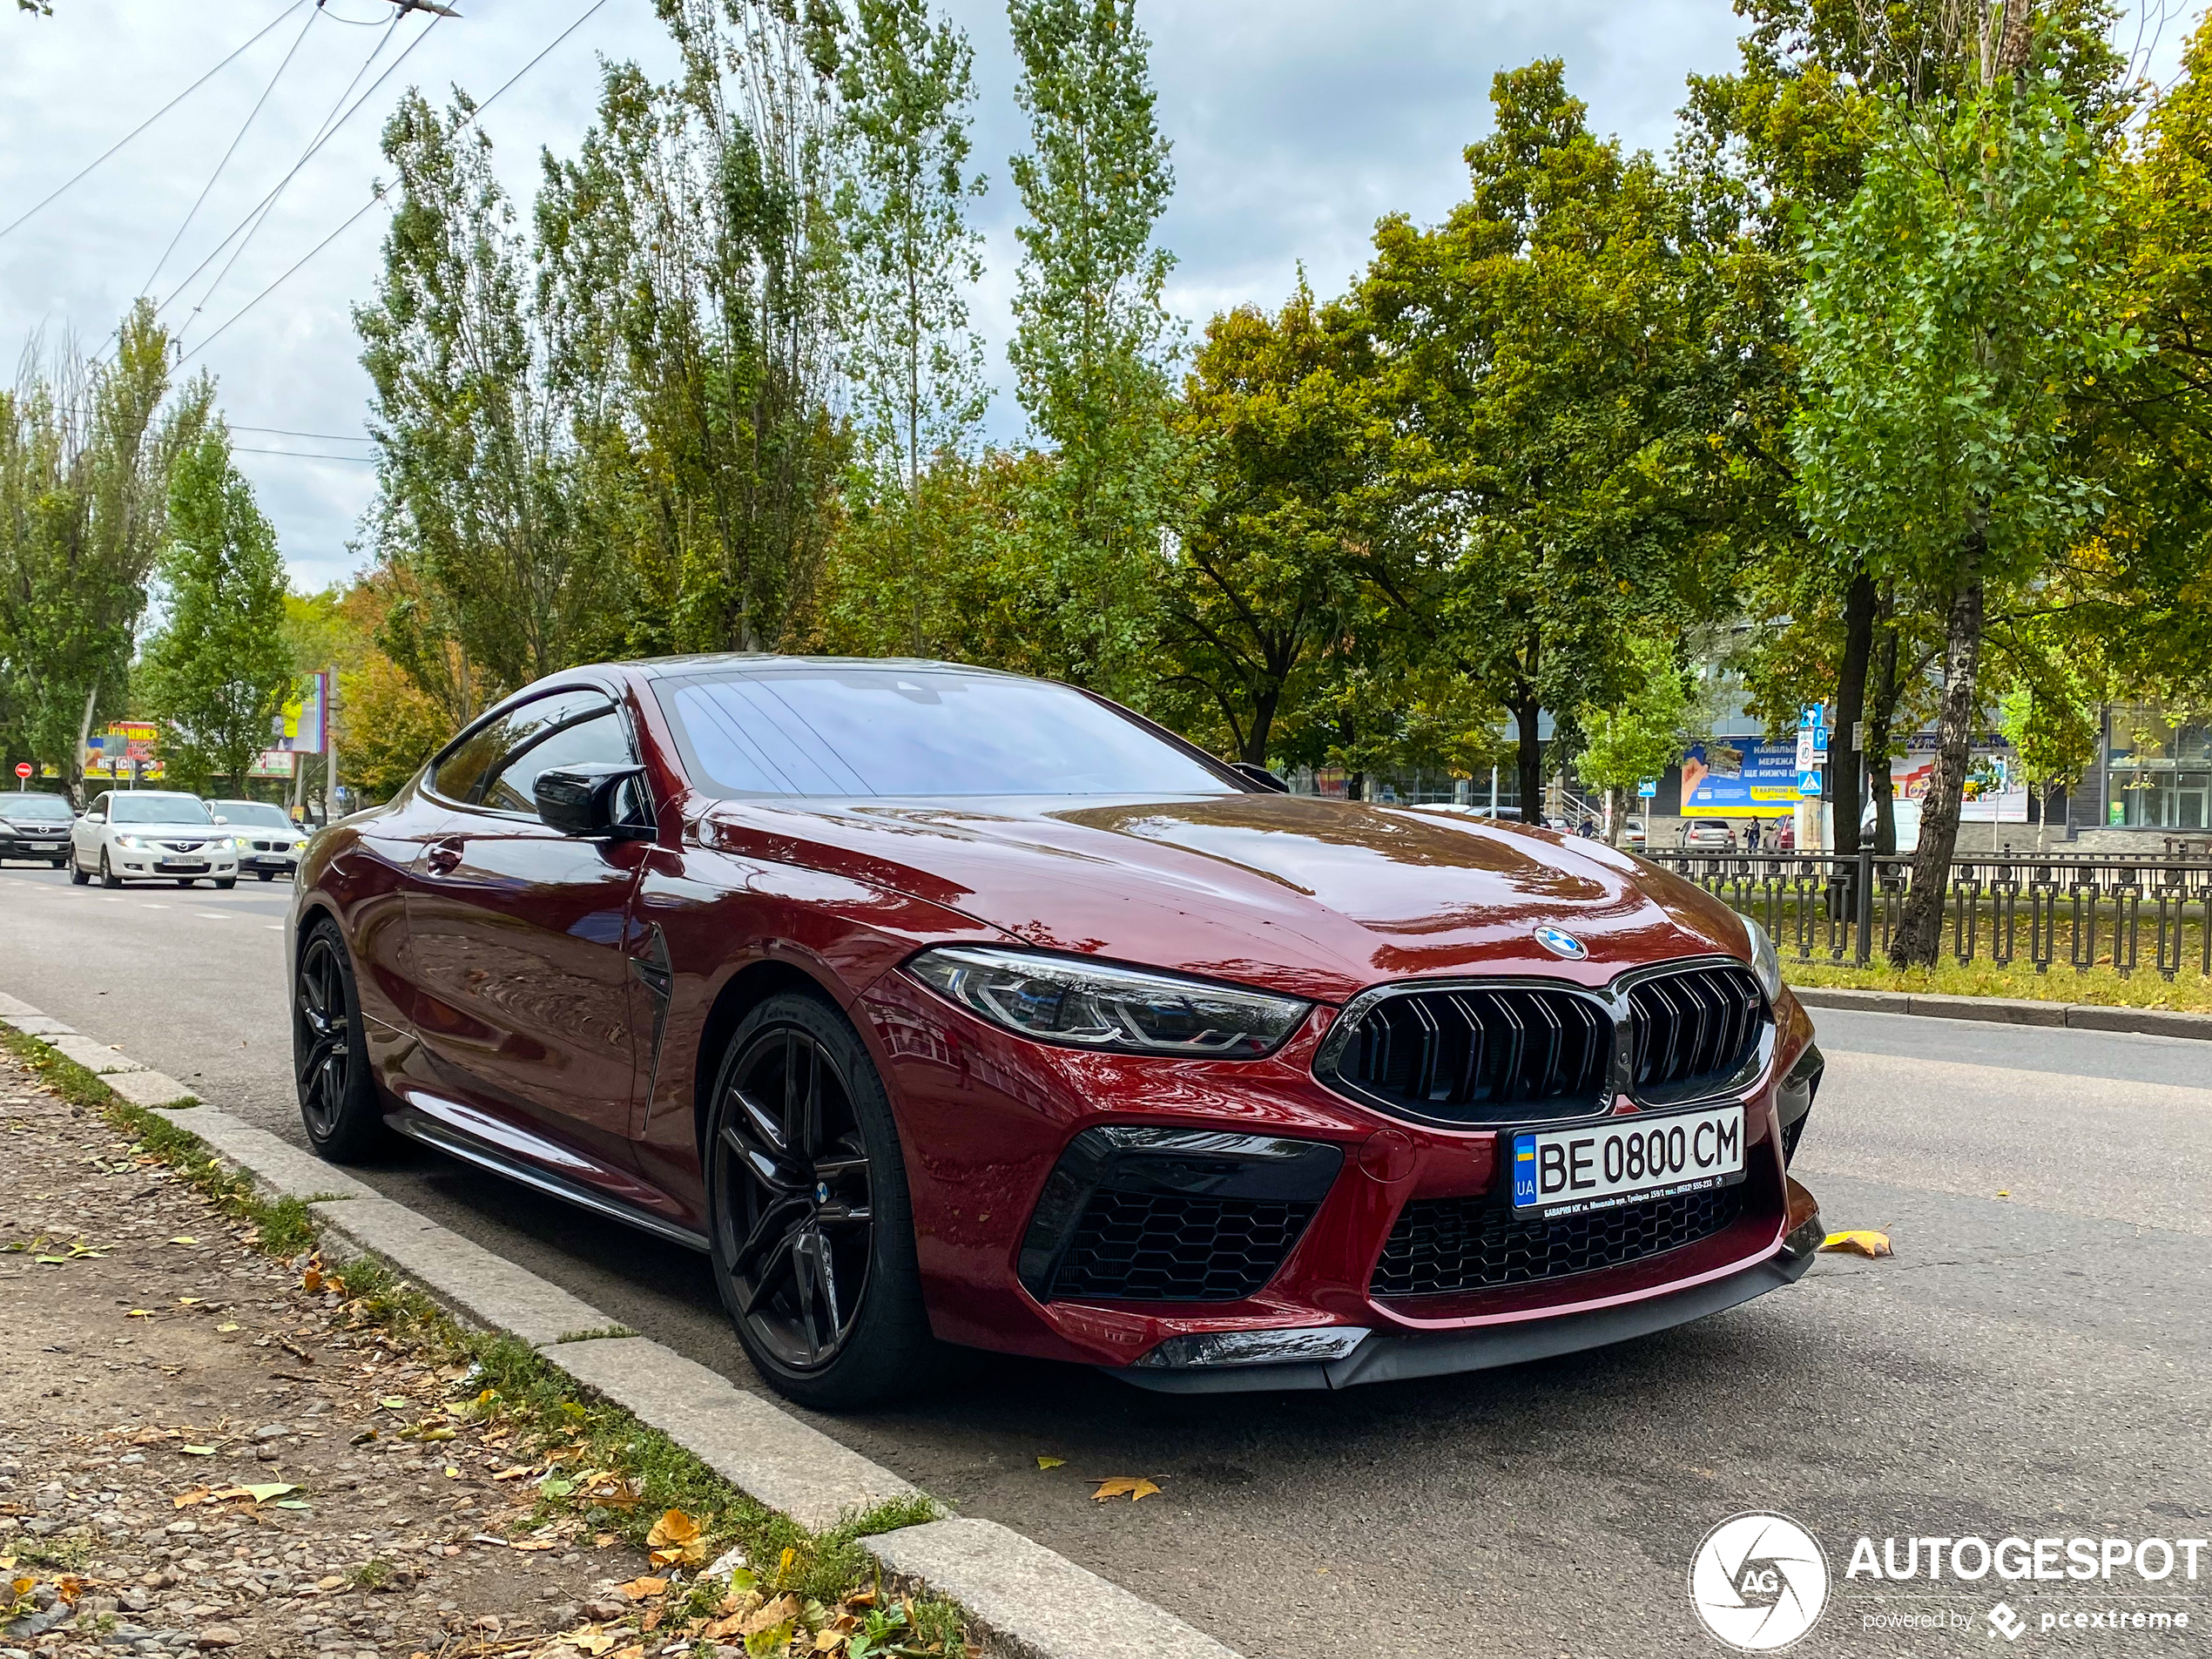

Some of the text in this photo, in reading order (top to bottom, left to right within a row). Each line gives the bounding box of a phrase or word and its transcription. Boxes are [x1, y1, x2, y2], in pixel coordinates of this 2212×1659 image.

[1817, 729, 1824, 746] P
[1743, 769, 1758, 778] ЩЕ
[1759, 769, 1788, 778] НИЖЧІ
[1540, 1116, 1738, 1195] BE 0800 CM
[1517, 1179, 1534, 1197] UA
[1544, 1205, 1572, 1218] БАВАРИЯ
[1572, 1204, 1582, 1213] ЮГ
